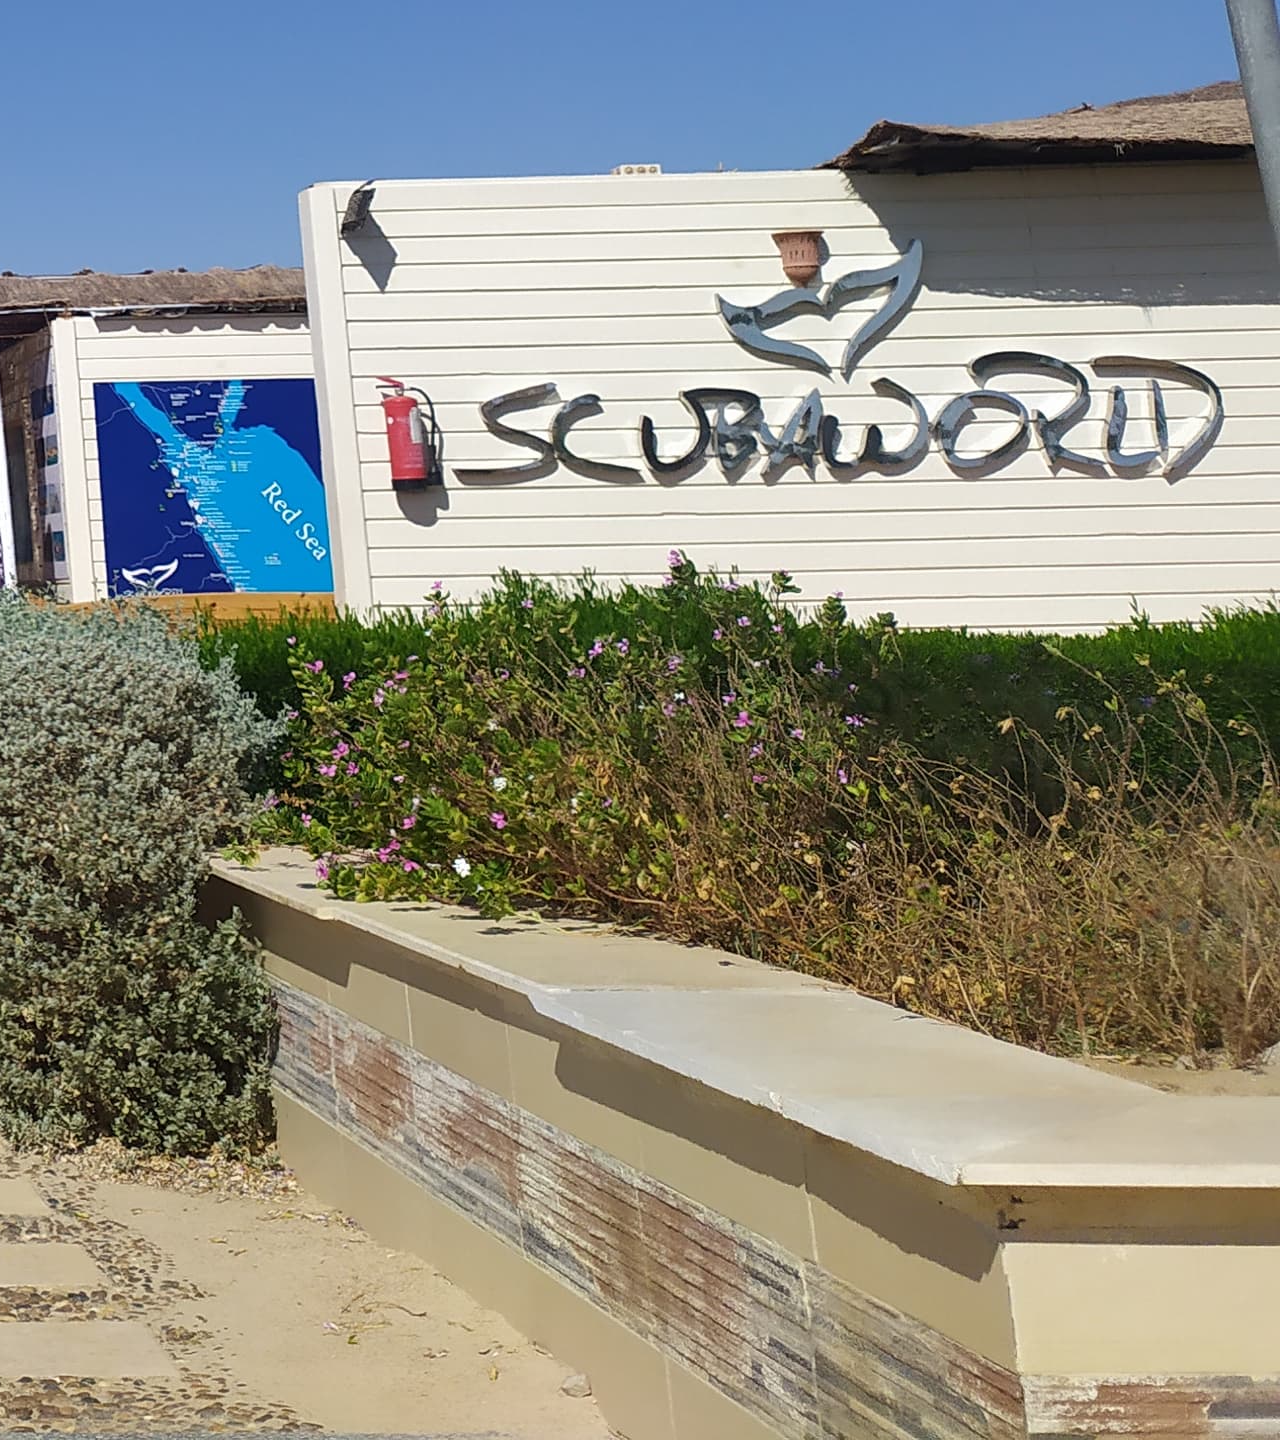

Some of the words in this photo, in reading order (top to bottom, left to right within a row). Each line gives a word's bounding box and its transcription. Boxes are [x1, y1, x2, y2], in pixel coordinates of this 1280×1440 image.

[453, 351, 1224, 483] SCUBAWORLD
[261, 481, 302, 525] Red
[295, 522, 327, 561] Sea
